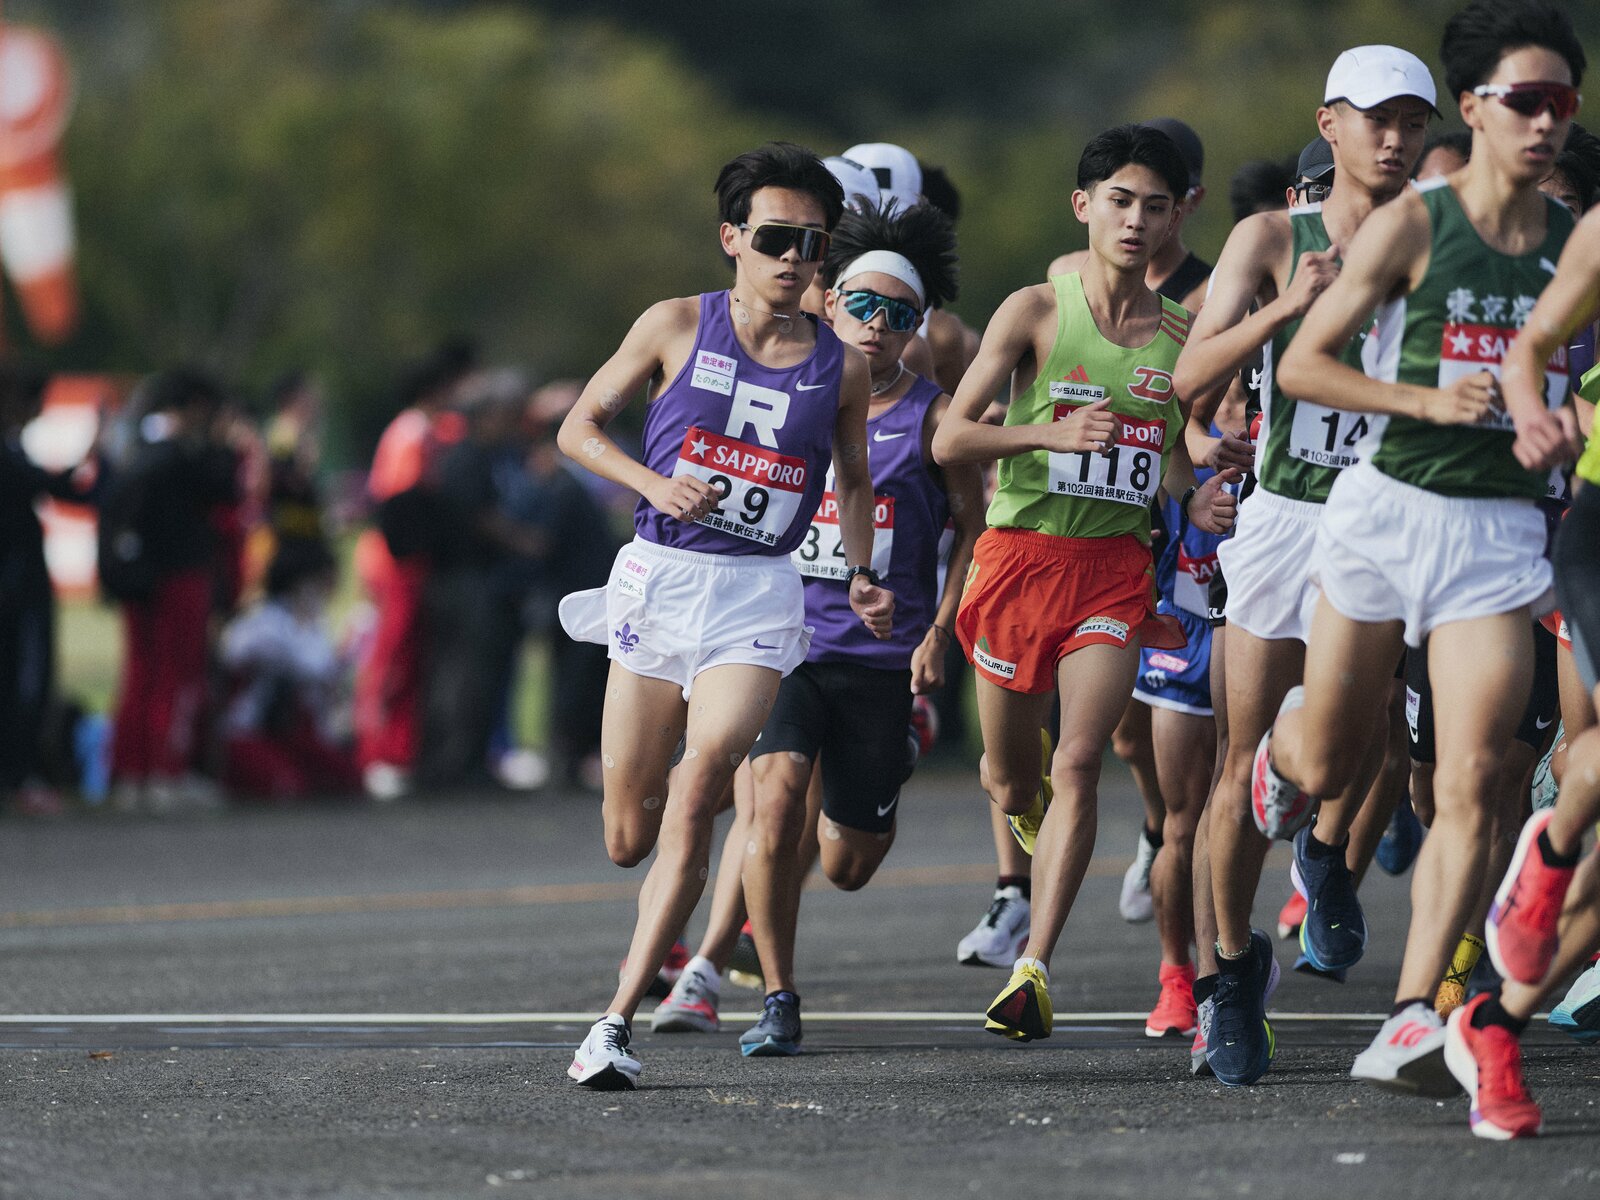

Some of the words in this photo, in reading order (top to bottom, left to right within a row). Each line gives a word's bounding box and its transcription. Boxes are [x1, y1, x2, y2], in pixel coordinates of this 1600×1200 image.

[695, 373, 731, 390] たのめーる
[1063, 387, 1103, 398] SAURUS
[724, 380, 791, 449] R
[713, 445, 805, 486] SAPPORO
[1074, 447, 1151, 491] 118
[707, 474, 770, 525] 29
[979, 654, 1014, 675] SAURUS
